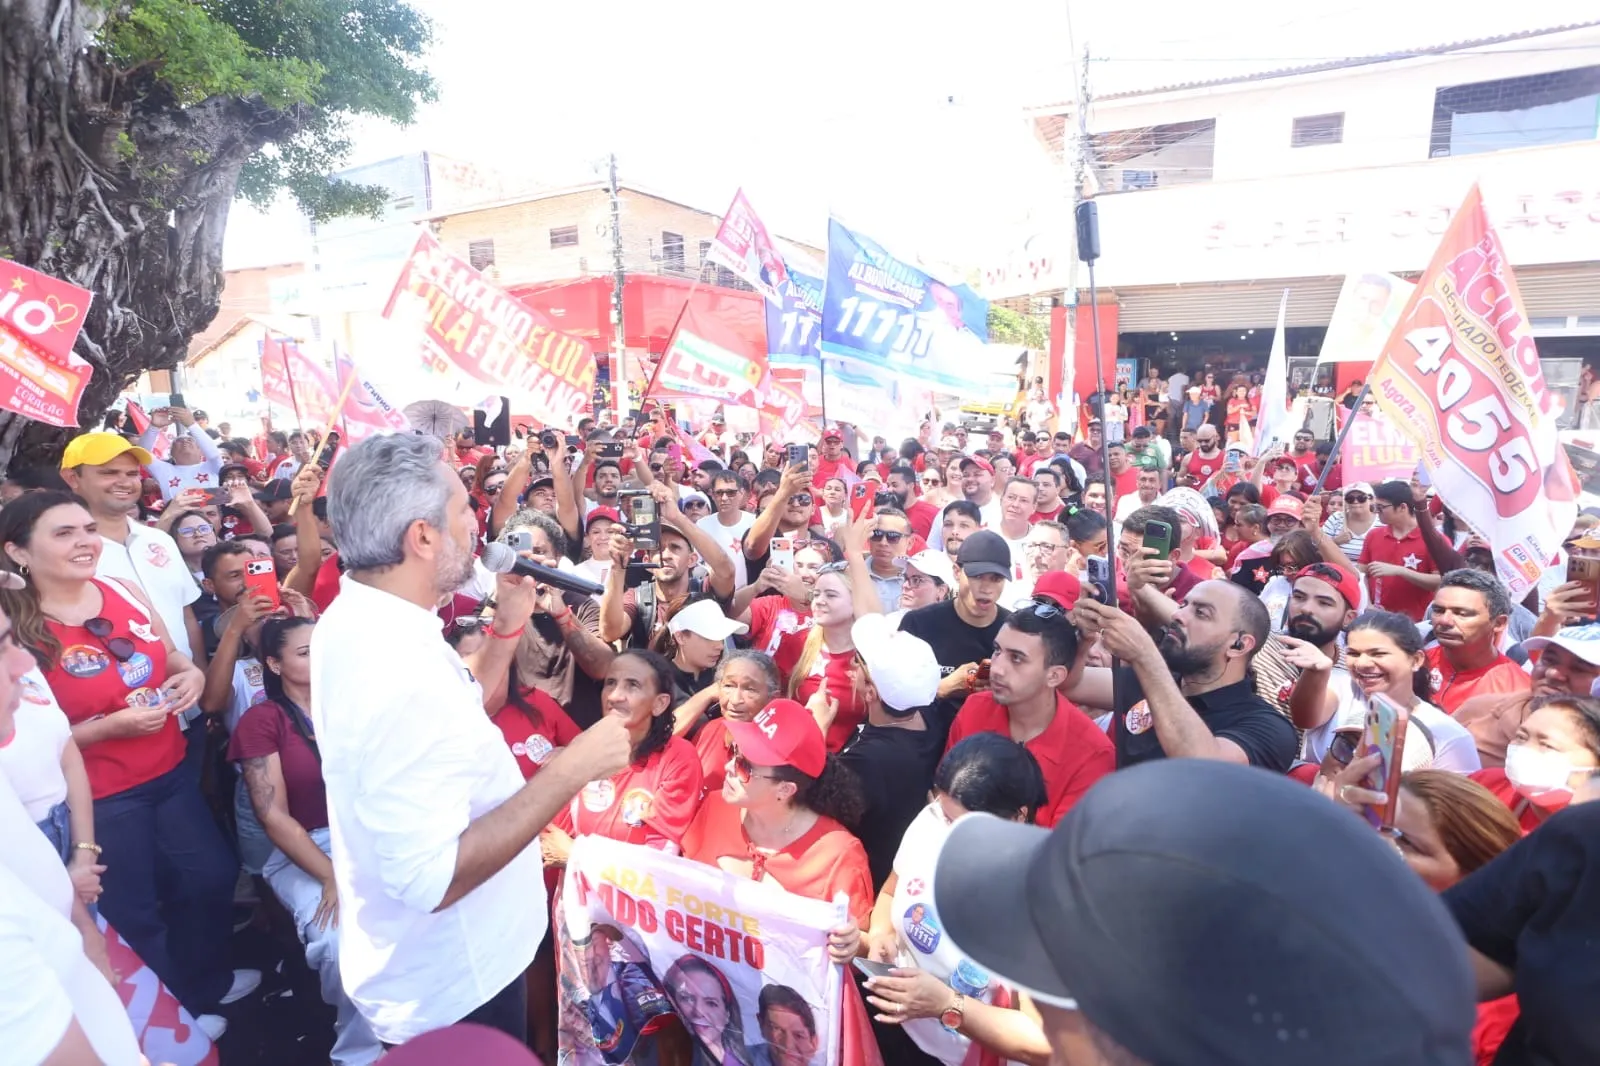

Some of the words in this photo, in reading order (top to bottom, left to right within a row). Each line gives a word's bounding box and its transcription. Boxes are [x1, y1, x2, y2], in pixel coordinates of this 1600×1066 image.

[836, 296, 934, 358] 11111
[536, 333, 597, 394] LULA
[1380, 378, 1415, 419] Agora,
[1404, 325, 1540, 495] 4055
[1512, 547, 1528, 563] CID
[666, 886, 761, 936] FORTE
[909, 923, 934, 947] 11111
[665, 909, 765, 970] CERTO
